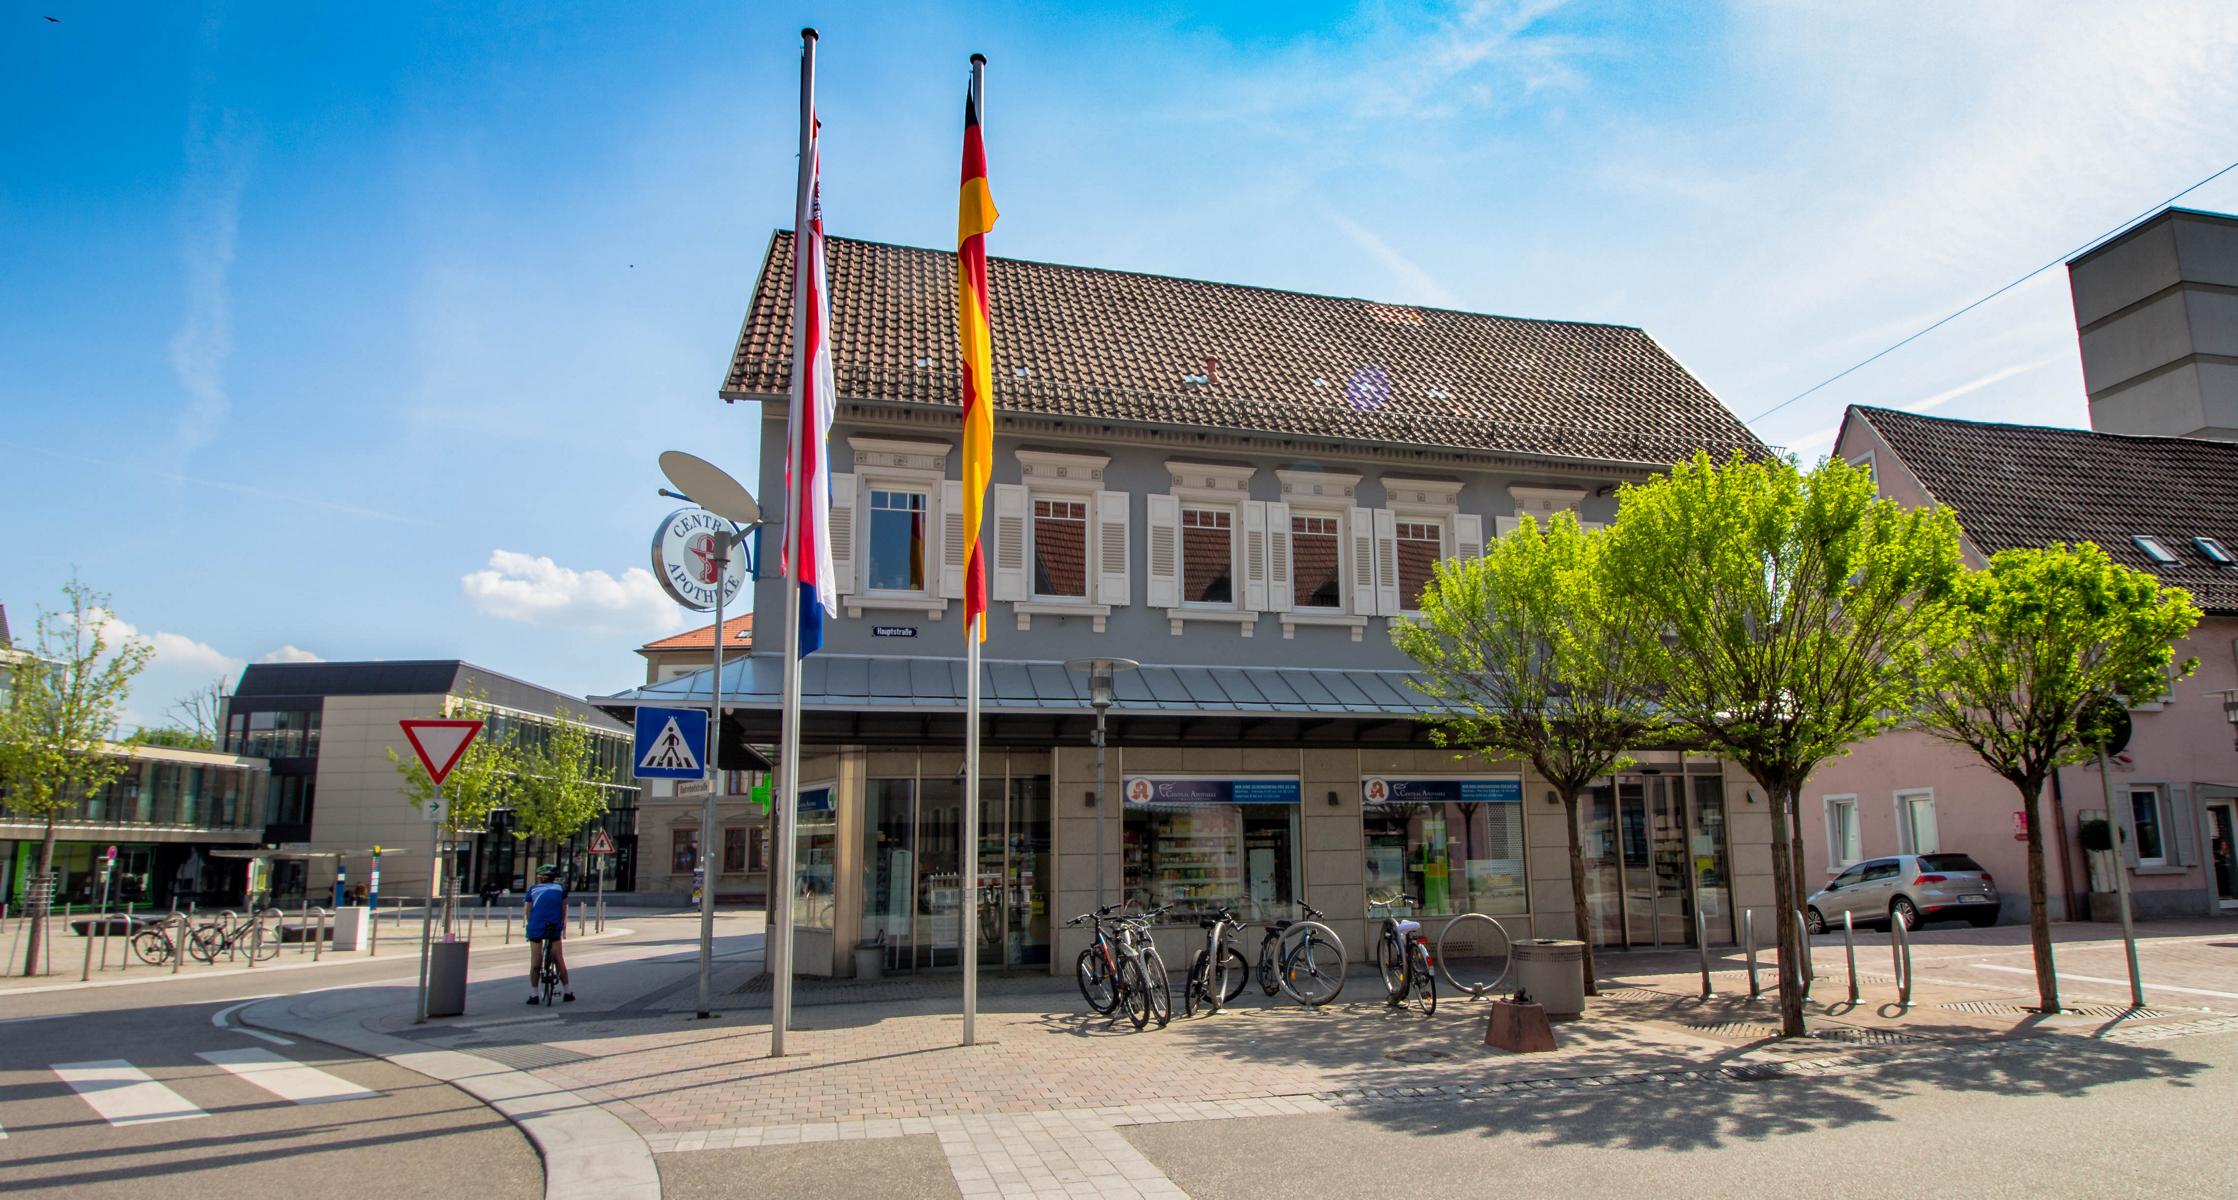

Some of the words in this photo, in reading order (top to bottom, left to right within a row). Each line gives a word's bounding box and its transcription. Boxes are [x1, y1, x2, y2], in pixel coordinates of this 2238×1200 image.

[674, 514, 722, 538] CENTR
[669, 562, 739, 603] APOTHKE
[877, 627, 912, 636] Hauptstraße
